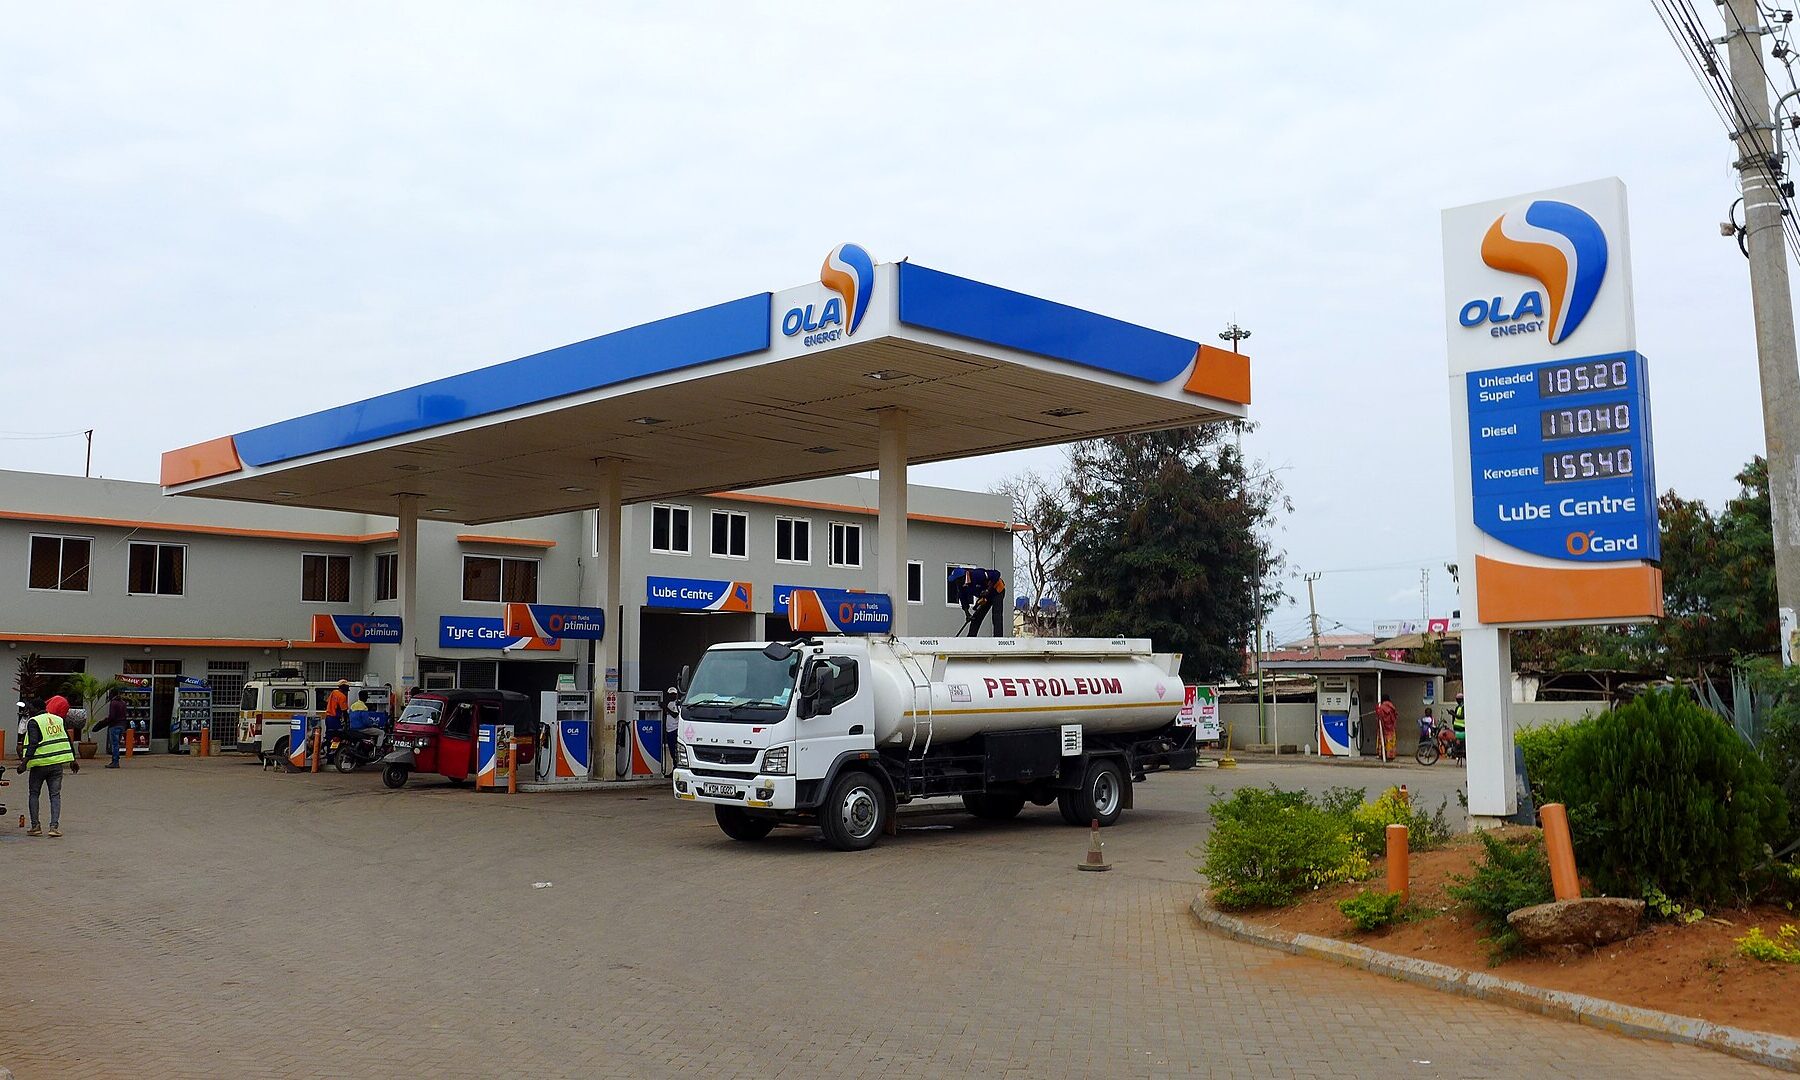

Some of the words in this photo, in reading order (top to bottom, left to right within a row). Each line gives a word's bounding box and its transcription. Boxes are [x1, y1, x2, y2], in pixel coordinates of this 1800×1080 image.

[782, 297, 842, 337] OLA
[1459, 291, 1544, 327] OLA
[1490, 320, 1544, 337] ENERGY
[804, 329, 843, 347] ENERGY
[1478, 371, 1533, 388] Unleaded
[1548, 361, 1627, 393] 185.20
[1479, 389, 1516, 402] Super
[1481, 423, 1517, 438] Diesel
[1551, 404, 1630, 435] 170.40
[1483, 466, 1539, 480] Kerosene
[1553, 448, 1632, 479] 155.40
[1498, 502, 1551, 522] Lube
[1559, 495, 1636, 517] Centre
[652, 586, 677, 598] Lube
[680, 588, 713, 600] Centre
[446, 626, 474, 640] Tyre
[478, 627, 505, 639] Care
[184, 677, 200, 685] Accel
[982, 677, 1123, 699] PETROLEUM
[46, 725, 62, 735] ICON
[696, 737, 753, 745] FUSO
